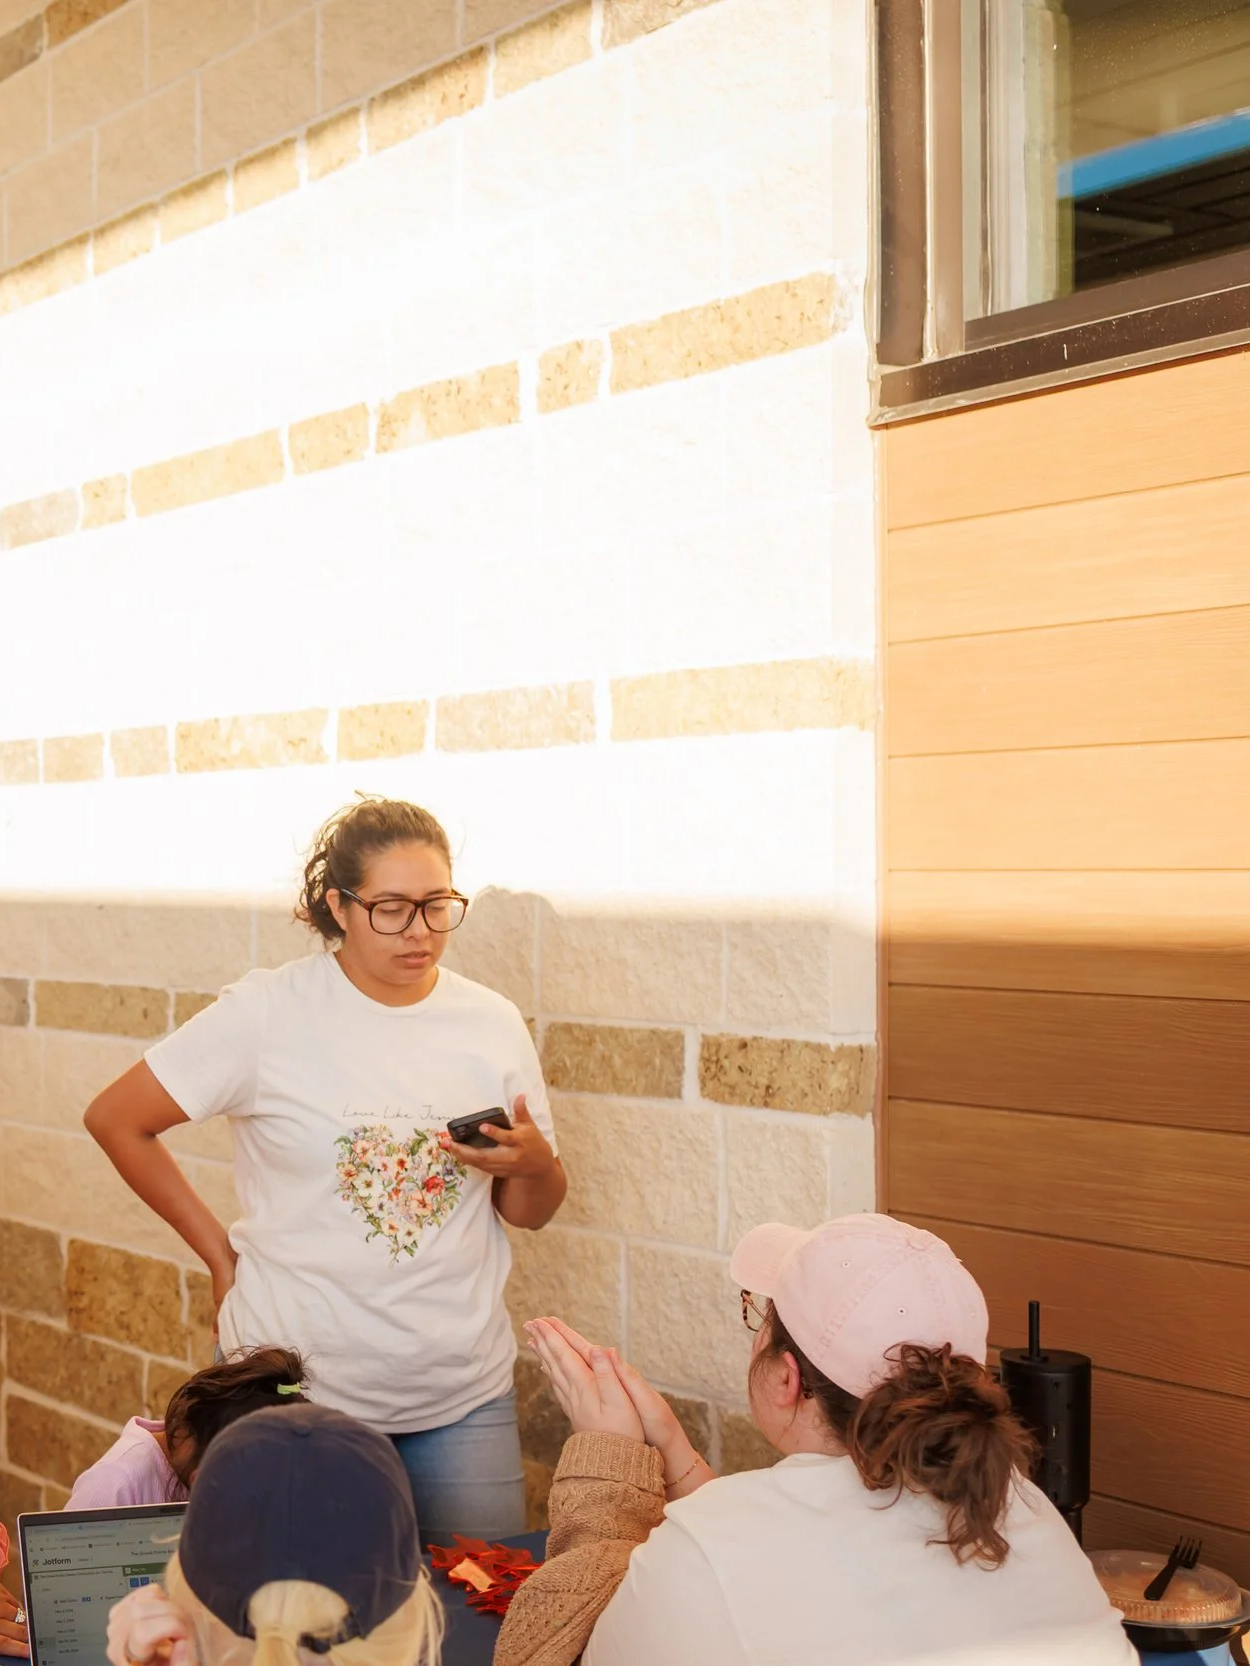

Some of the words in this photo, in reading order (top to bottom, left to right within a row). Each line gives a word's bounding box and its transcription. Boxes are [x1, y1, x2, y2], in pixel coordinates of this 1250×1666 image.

[342, 1102, 380, 1118] Love
[382, 1105, 414, 1120] Like
[42, 1557, 72, 1566] Jotform
